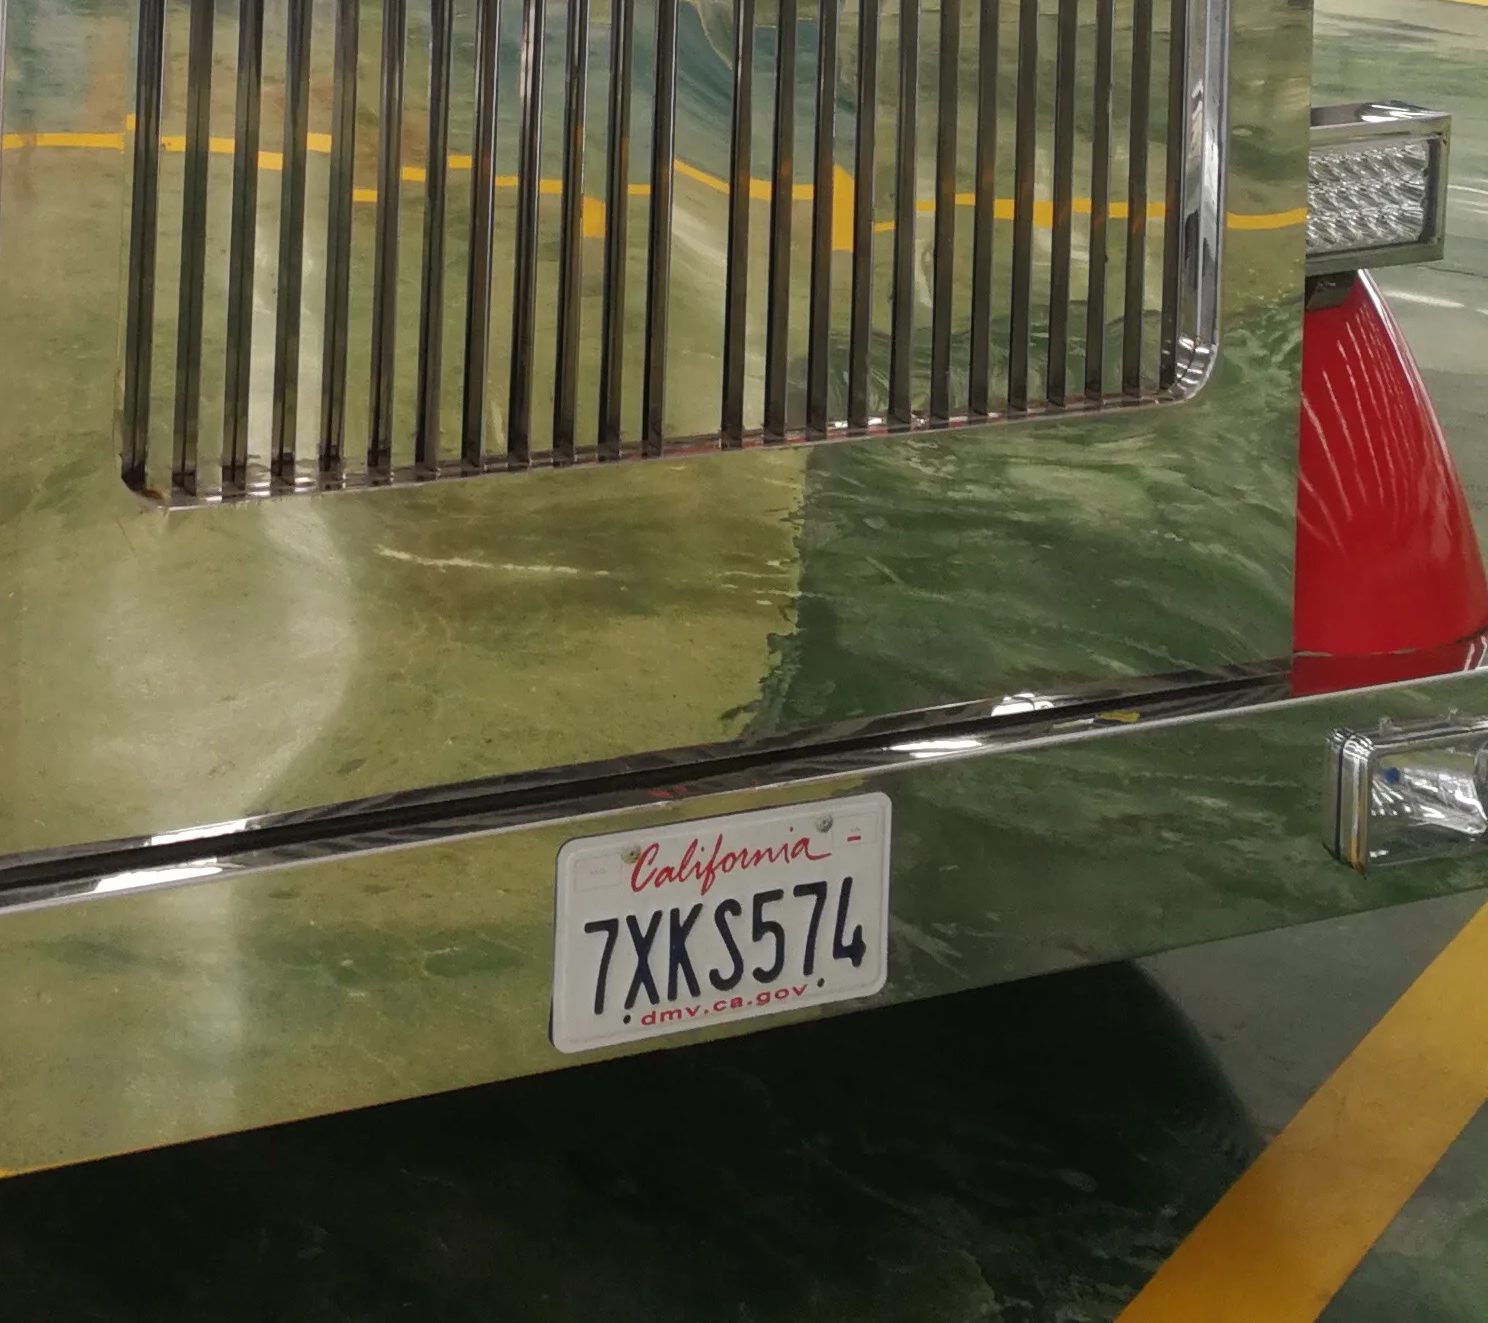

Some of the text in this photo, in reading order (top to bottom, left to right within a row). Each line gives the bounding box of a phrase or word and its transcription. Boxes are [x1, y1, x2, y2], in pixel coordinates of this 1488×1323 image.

[630, 826, 832, 896] California
[584, 875, 867, 1015] 7XKS574
[640, 983, 808, 1026] dmv.ca.gov
